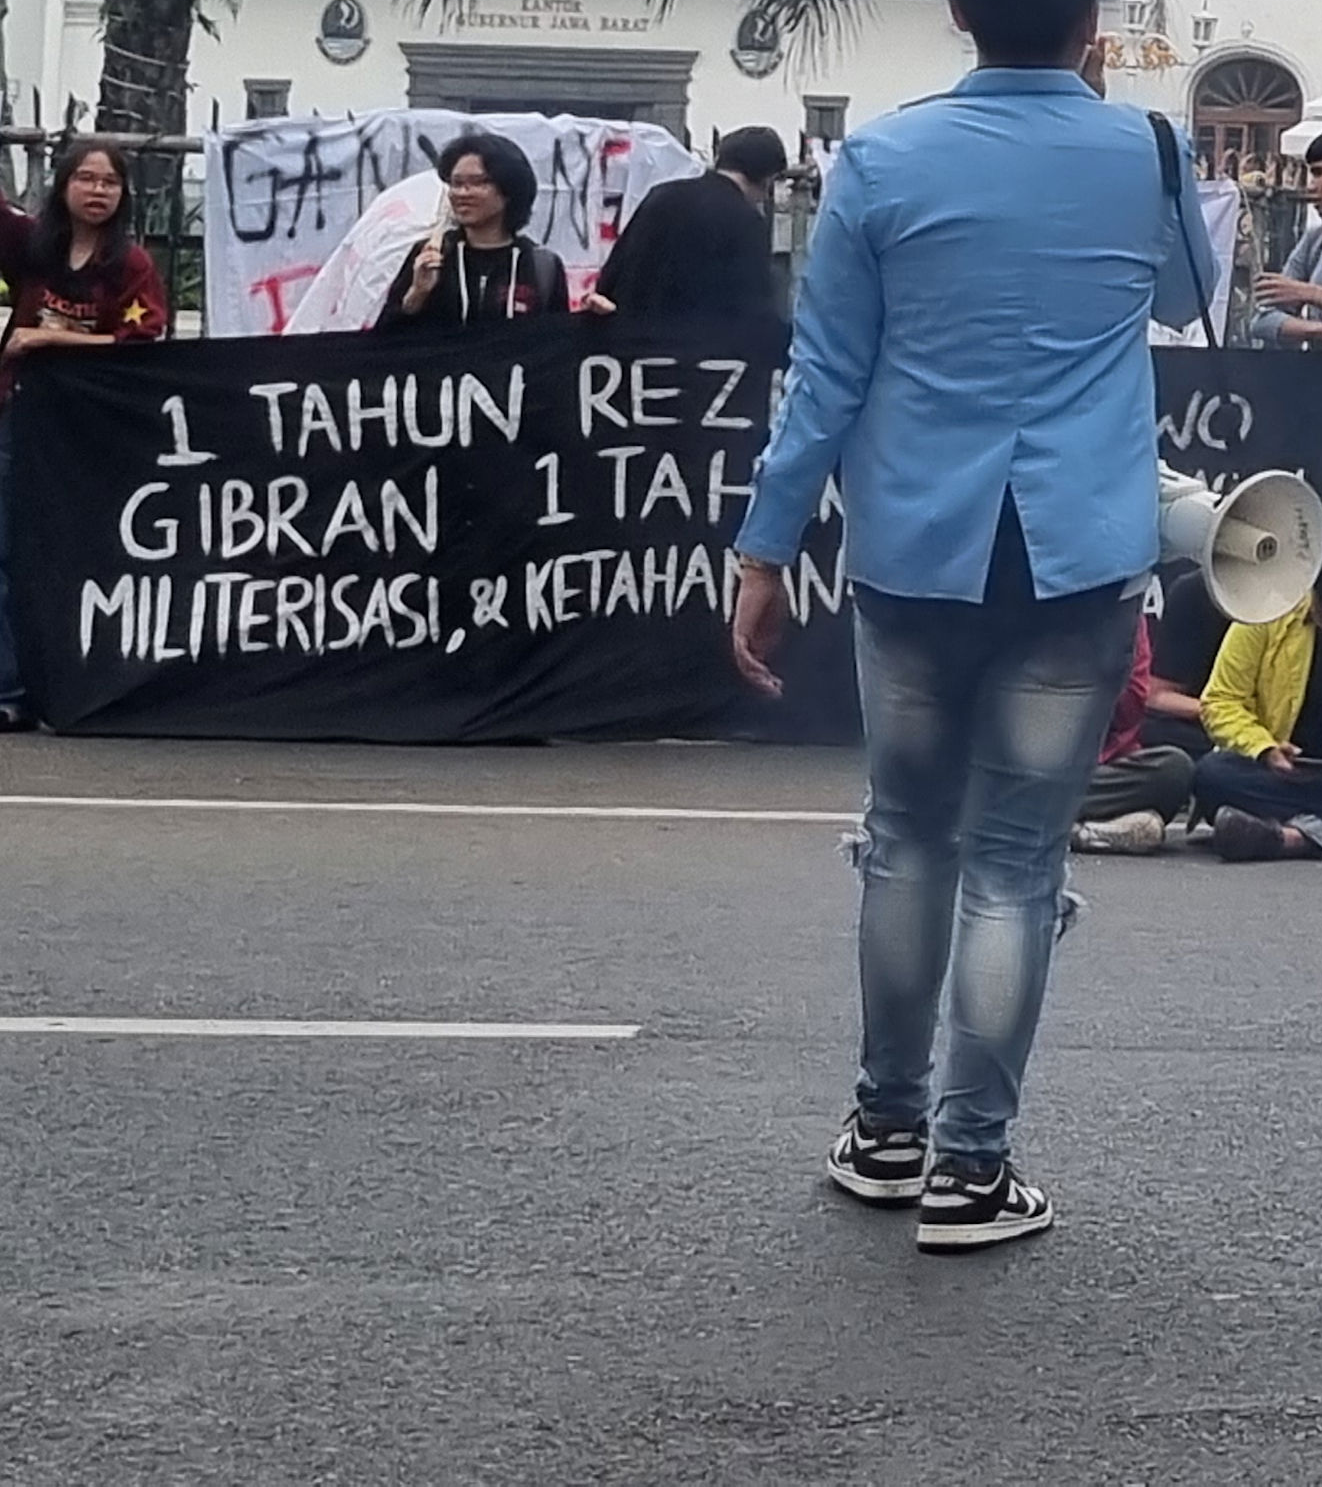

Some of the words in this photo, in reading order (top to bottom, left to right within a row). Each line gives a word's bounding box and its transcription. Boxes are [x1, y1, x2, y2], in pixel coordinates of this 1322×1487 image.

[551, 16, 591, 31] JAWA
[601, 17, 650, 32] BARAT
[156, 395, 220, 467] 1
[249, 362, 524, 458] TAHUN
[579, 354, 786, 439] REZI
[119, 465, 438, 560] GIBRAN
[534, 452, 576, 526] 1
[79, 573, 467, 664] MILITERISASI,
[469, 575, 509, 628] &
